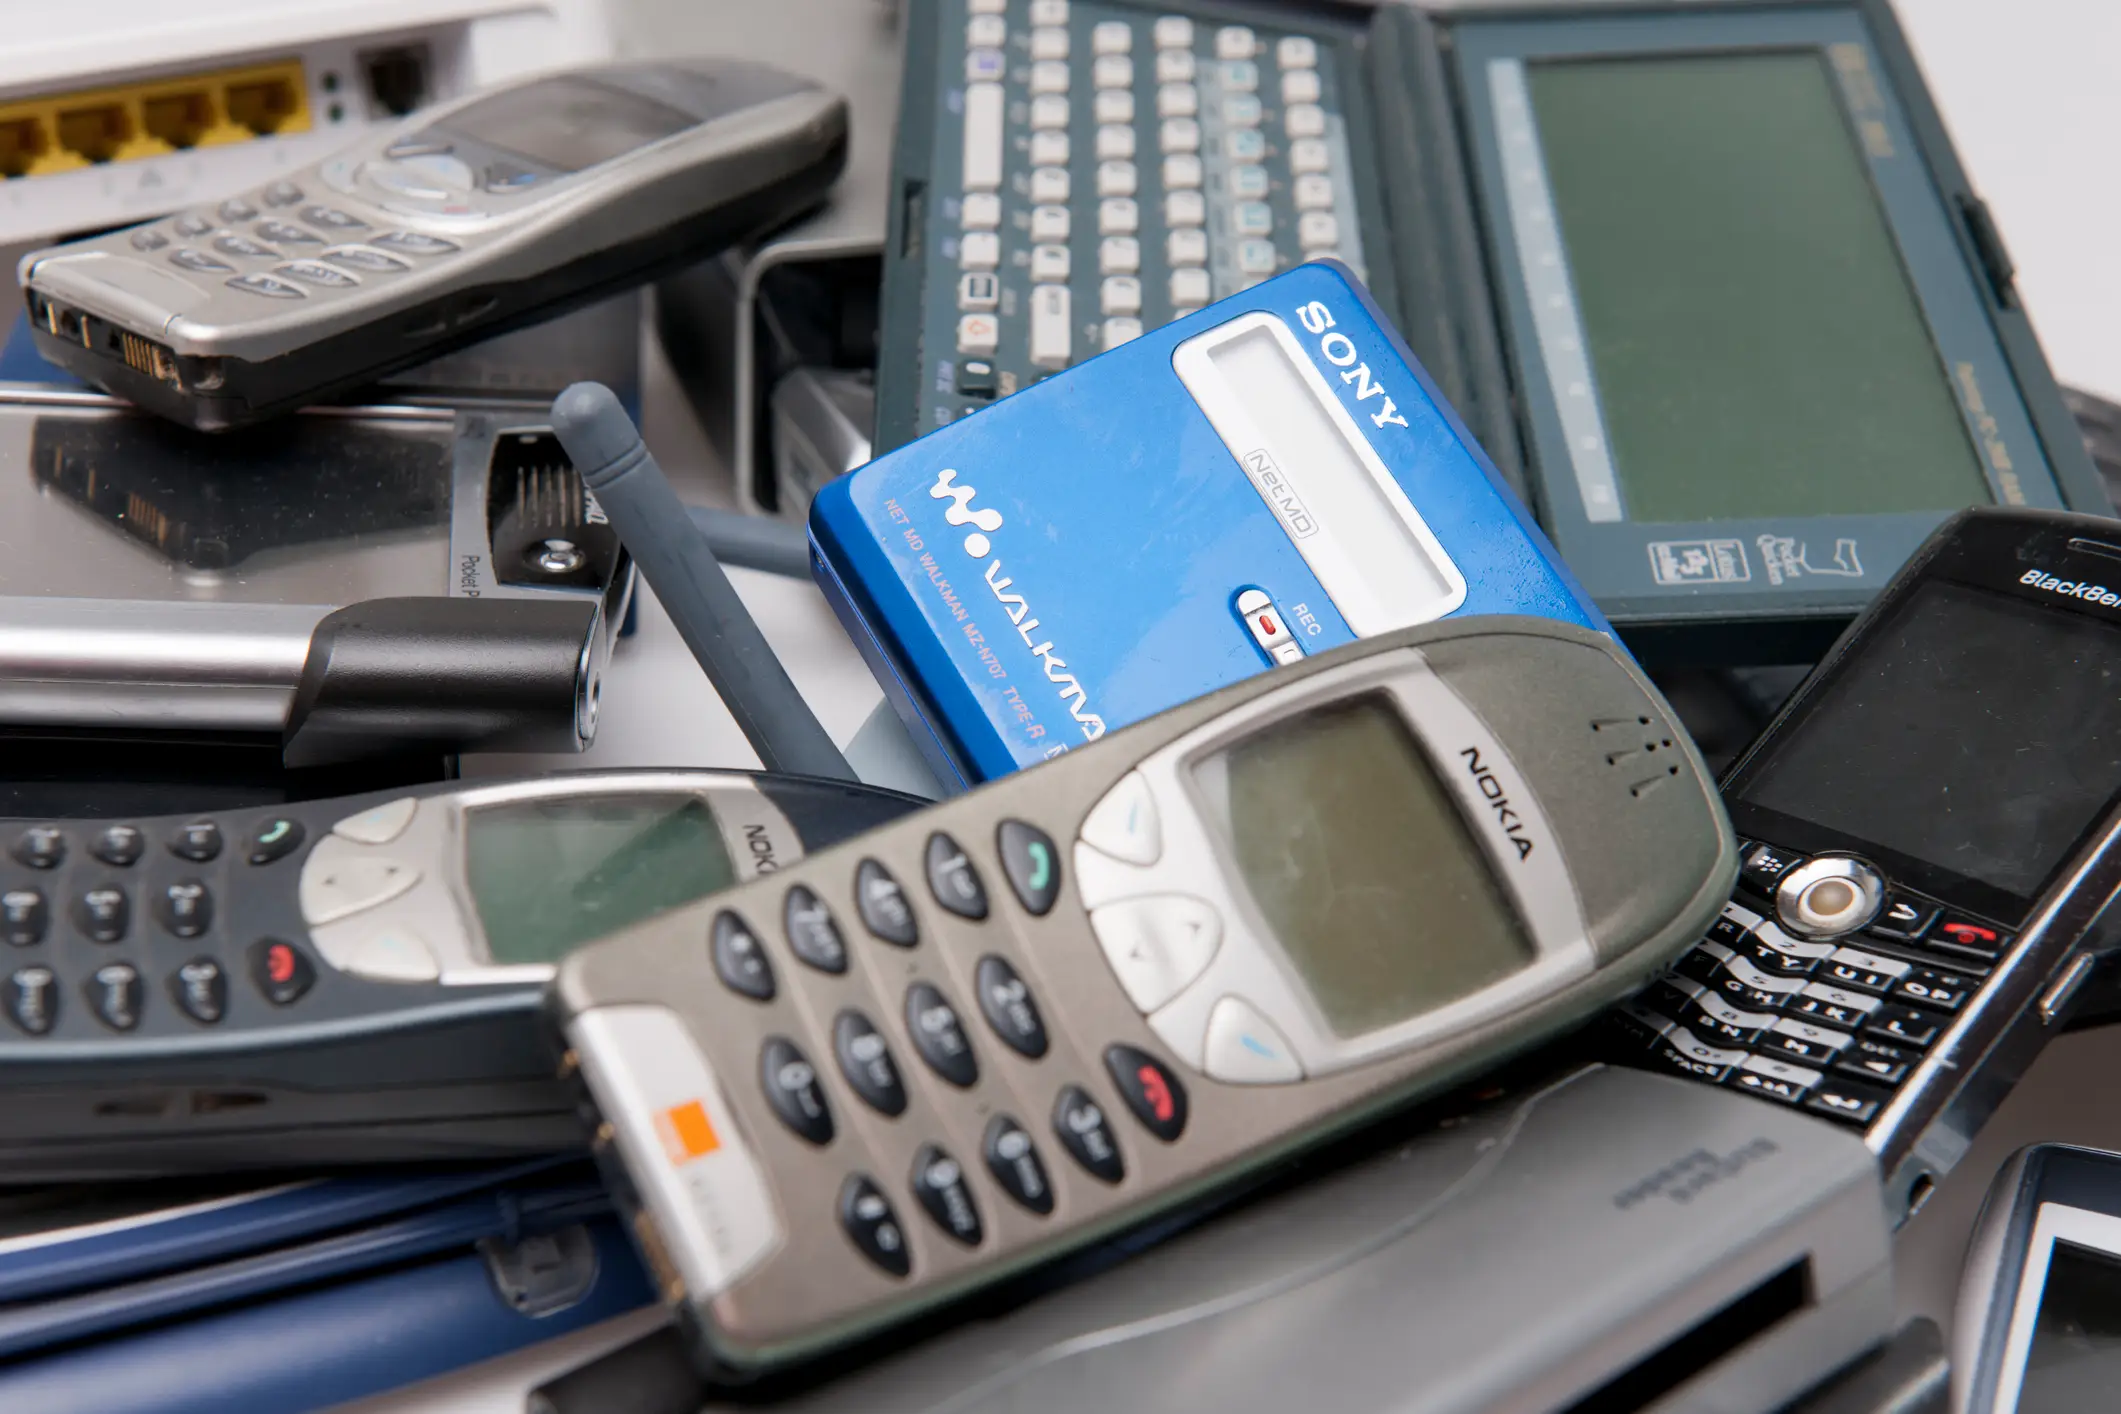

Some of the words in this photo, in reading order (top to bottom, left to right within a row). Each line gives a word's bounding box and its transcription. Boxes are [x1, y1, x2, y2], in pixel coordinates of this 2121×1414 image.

[1295, 301, 1408, 430] SONY
[461, 555, 481, 588] Pocket
[2019, 569, 2121, 608] BlackBer
[462, 590, 481, 598] P
[884, 499, 911, 525] NET
[903, 528, 925, 551] MD
[919, 552, 970, 623] WALKMAN
[962, 623, 1007, 680] MZ-N707
[1002, 686, 1046, 739] TYPE-R
[1292, 602, 1322, 636] REC
[984, 559, 1107, 742] WALKMA
[1460, 746, 1534, 862] NOKIA
[1663, 1049, 1720, 1076] SPACE
